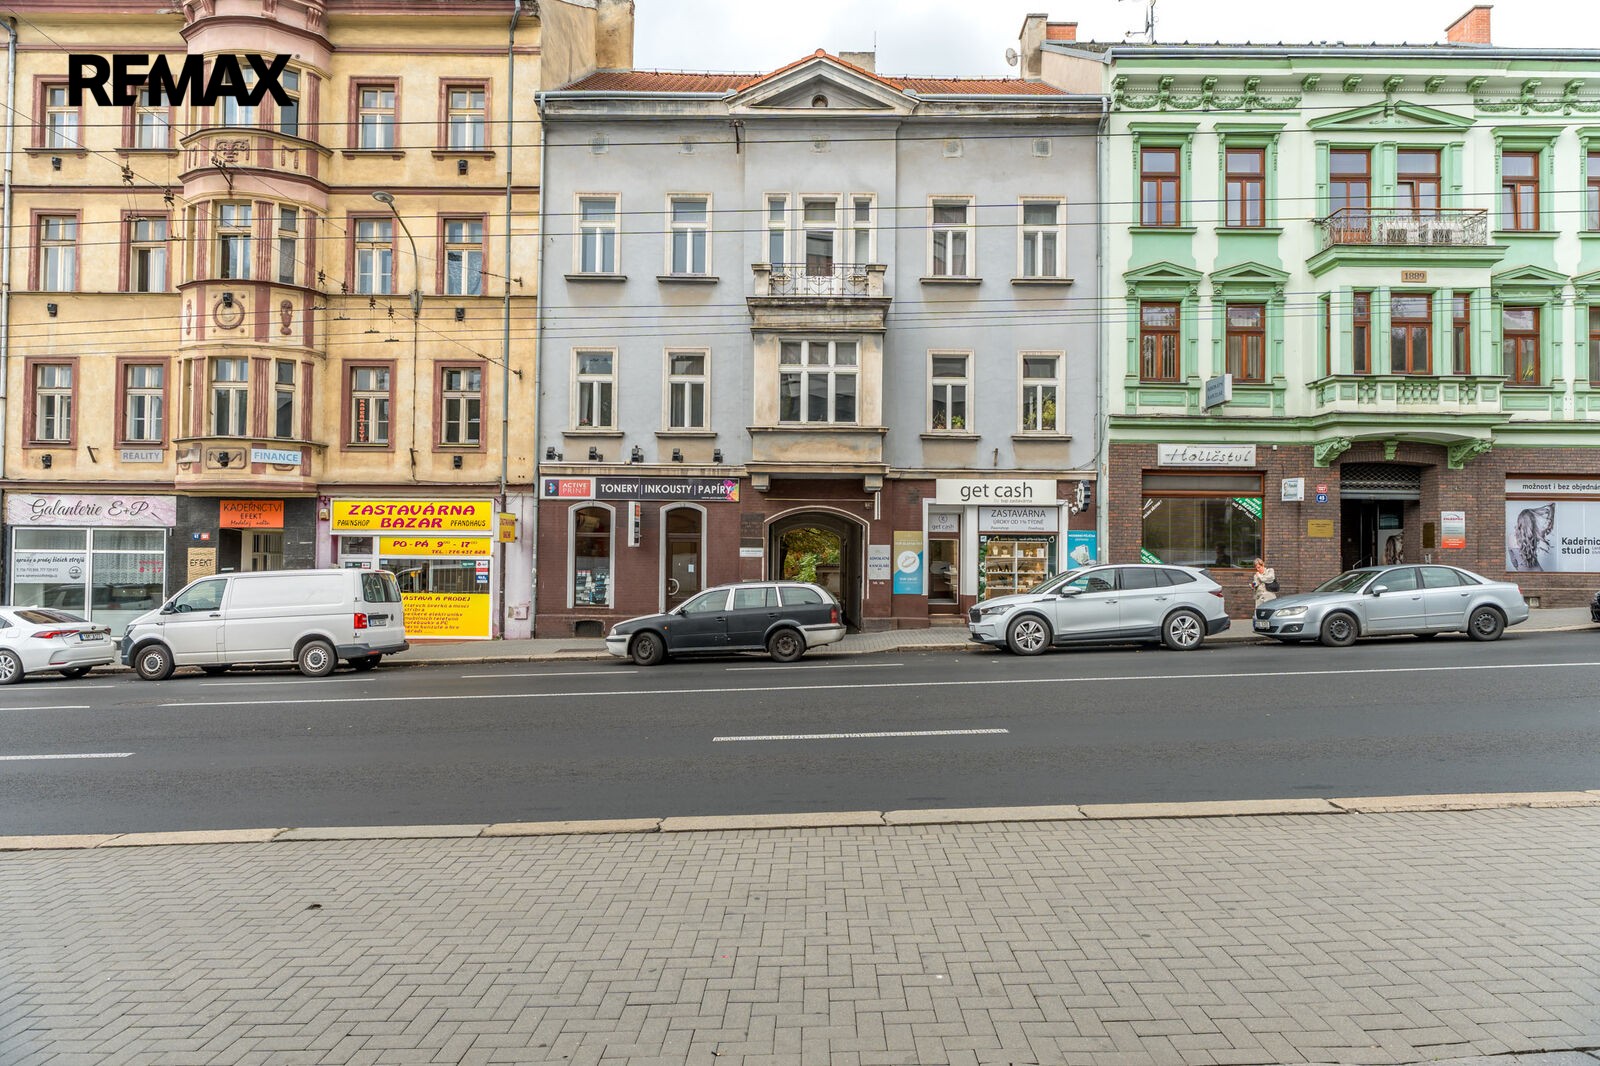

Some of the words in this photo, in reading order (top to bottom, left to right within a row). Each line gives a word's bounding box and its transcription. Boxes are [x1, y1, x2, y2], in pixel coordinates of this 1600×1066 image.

[1404, 272, 1425, 280] 1889
[122, 452, 160, 460] REALITY
[254, 451, 299, 462] FINANCE
[601, 484, 639, 493] TONERY
[644, 484, 692, 494] INKOUSTY
[698, 483, 732, 494] PAPÍRY
[960, 483, 989, 502] get
[994, 481, 1033, 498] cash
[27, 499, 103, 521] Galanterie
[348, 503, 476, 516] ZASTAVÁRNA
[991, 508, 1046, 518] ZASTAVÁRNA
[336, 519, 371, 527] PAWNSHOP
[380, 517, 443, 529] BAZAR
[450, 519, 486, 527] PFANDHAUS
[414, 539, 429, 547] PÁ
[1561, 546, 1590, 555] studio
[189, 558, 213, 567] EFEKT
